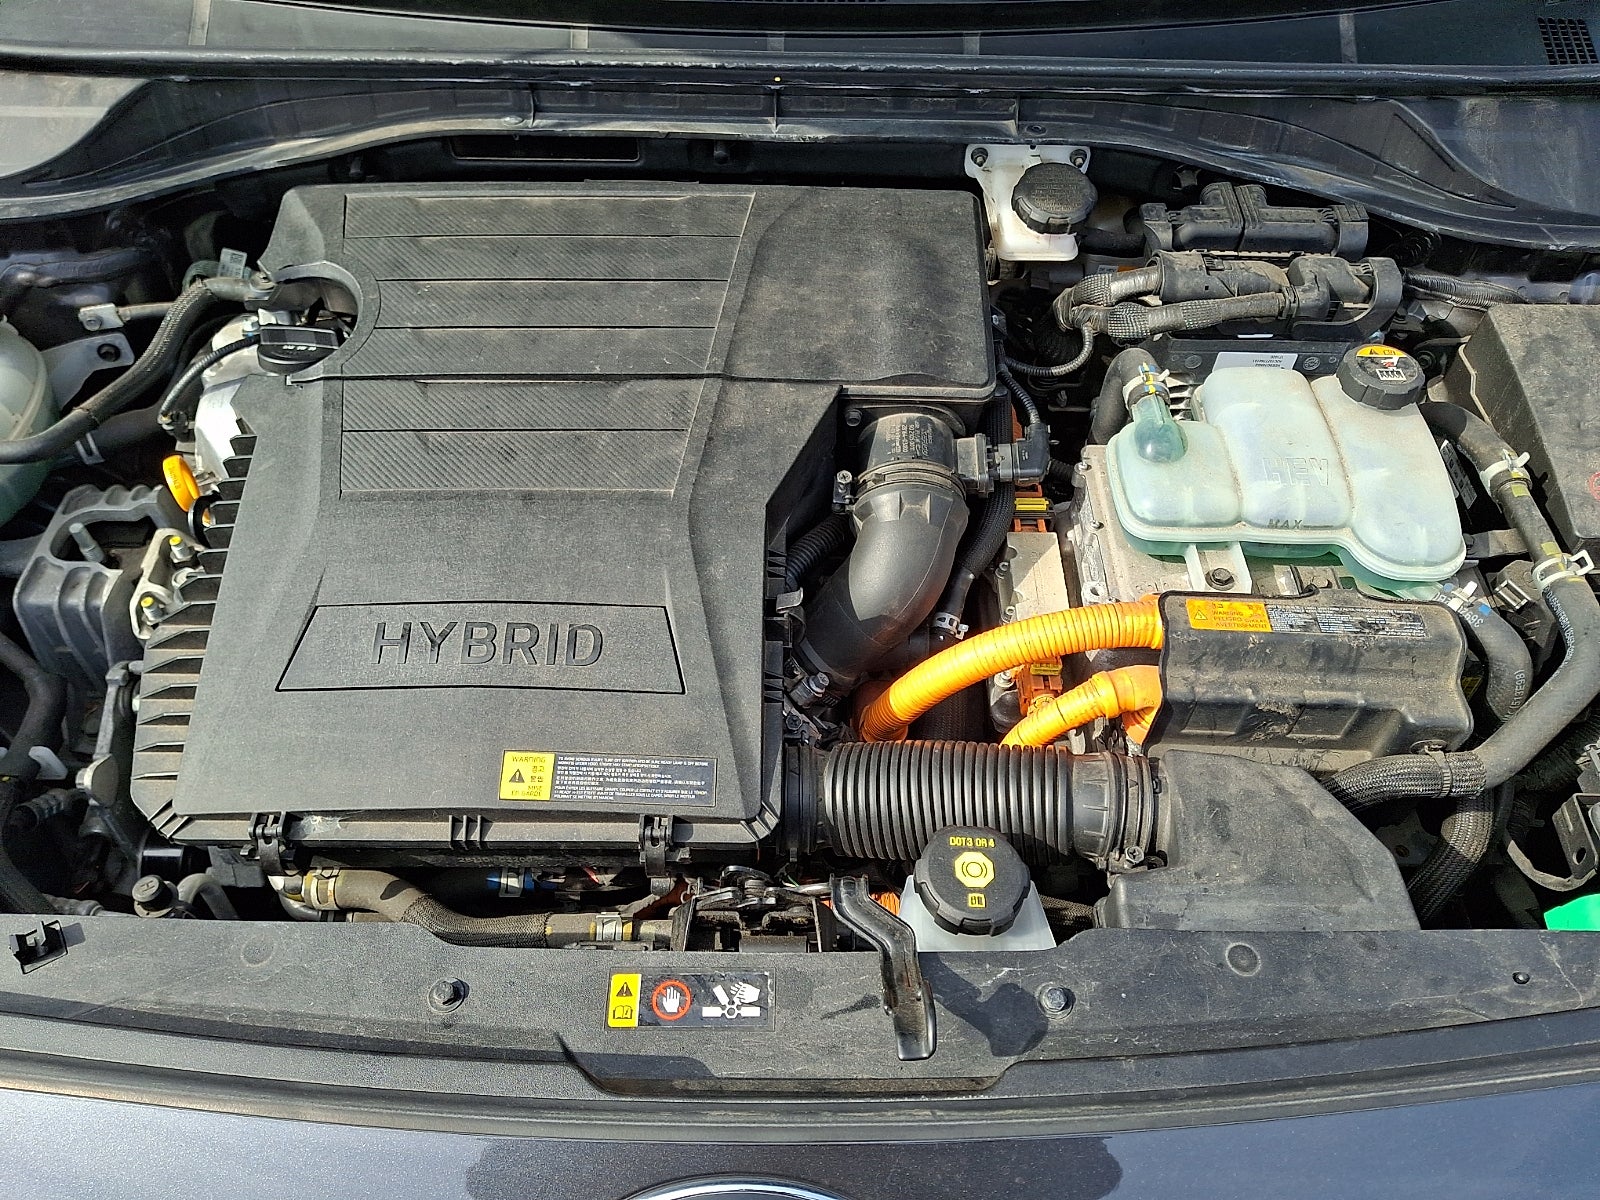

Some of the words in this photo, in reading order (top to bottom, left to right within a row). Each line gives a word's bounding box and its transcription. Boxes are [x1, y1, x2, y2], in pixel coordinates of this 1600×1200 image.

[1262, 457, 1329, 487] HEV
[1268, 518, 1303, 530] MAX
[371, 621, 604, 667] HYBRID
[949, 836, 973, 847] DOT3
[975, 837, 988, 848] OR
[988, 838, 996, 848] 4
